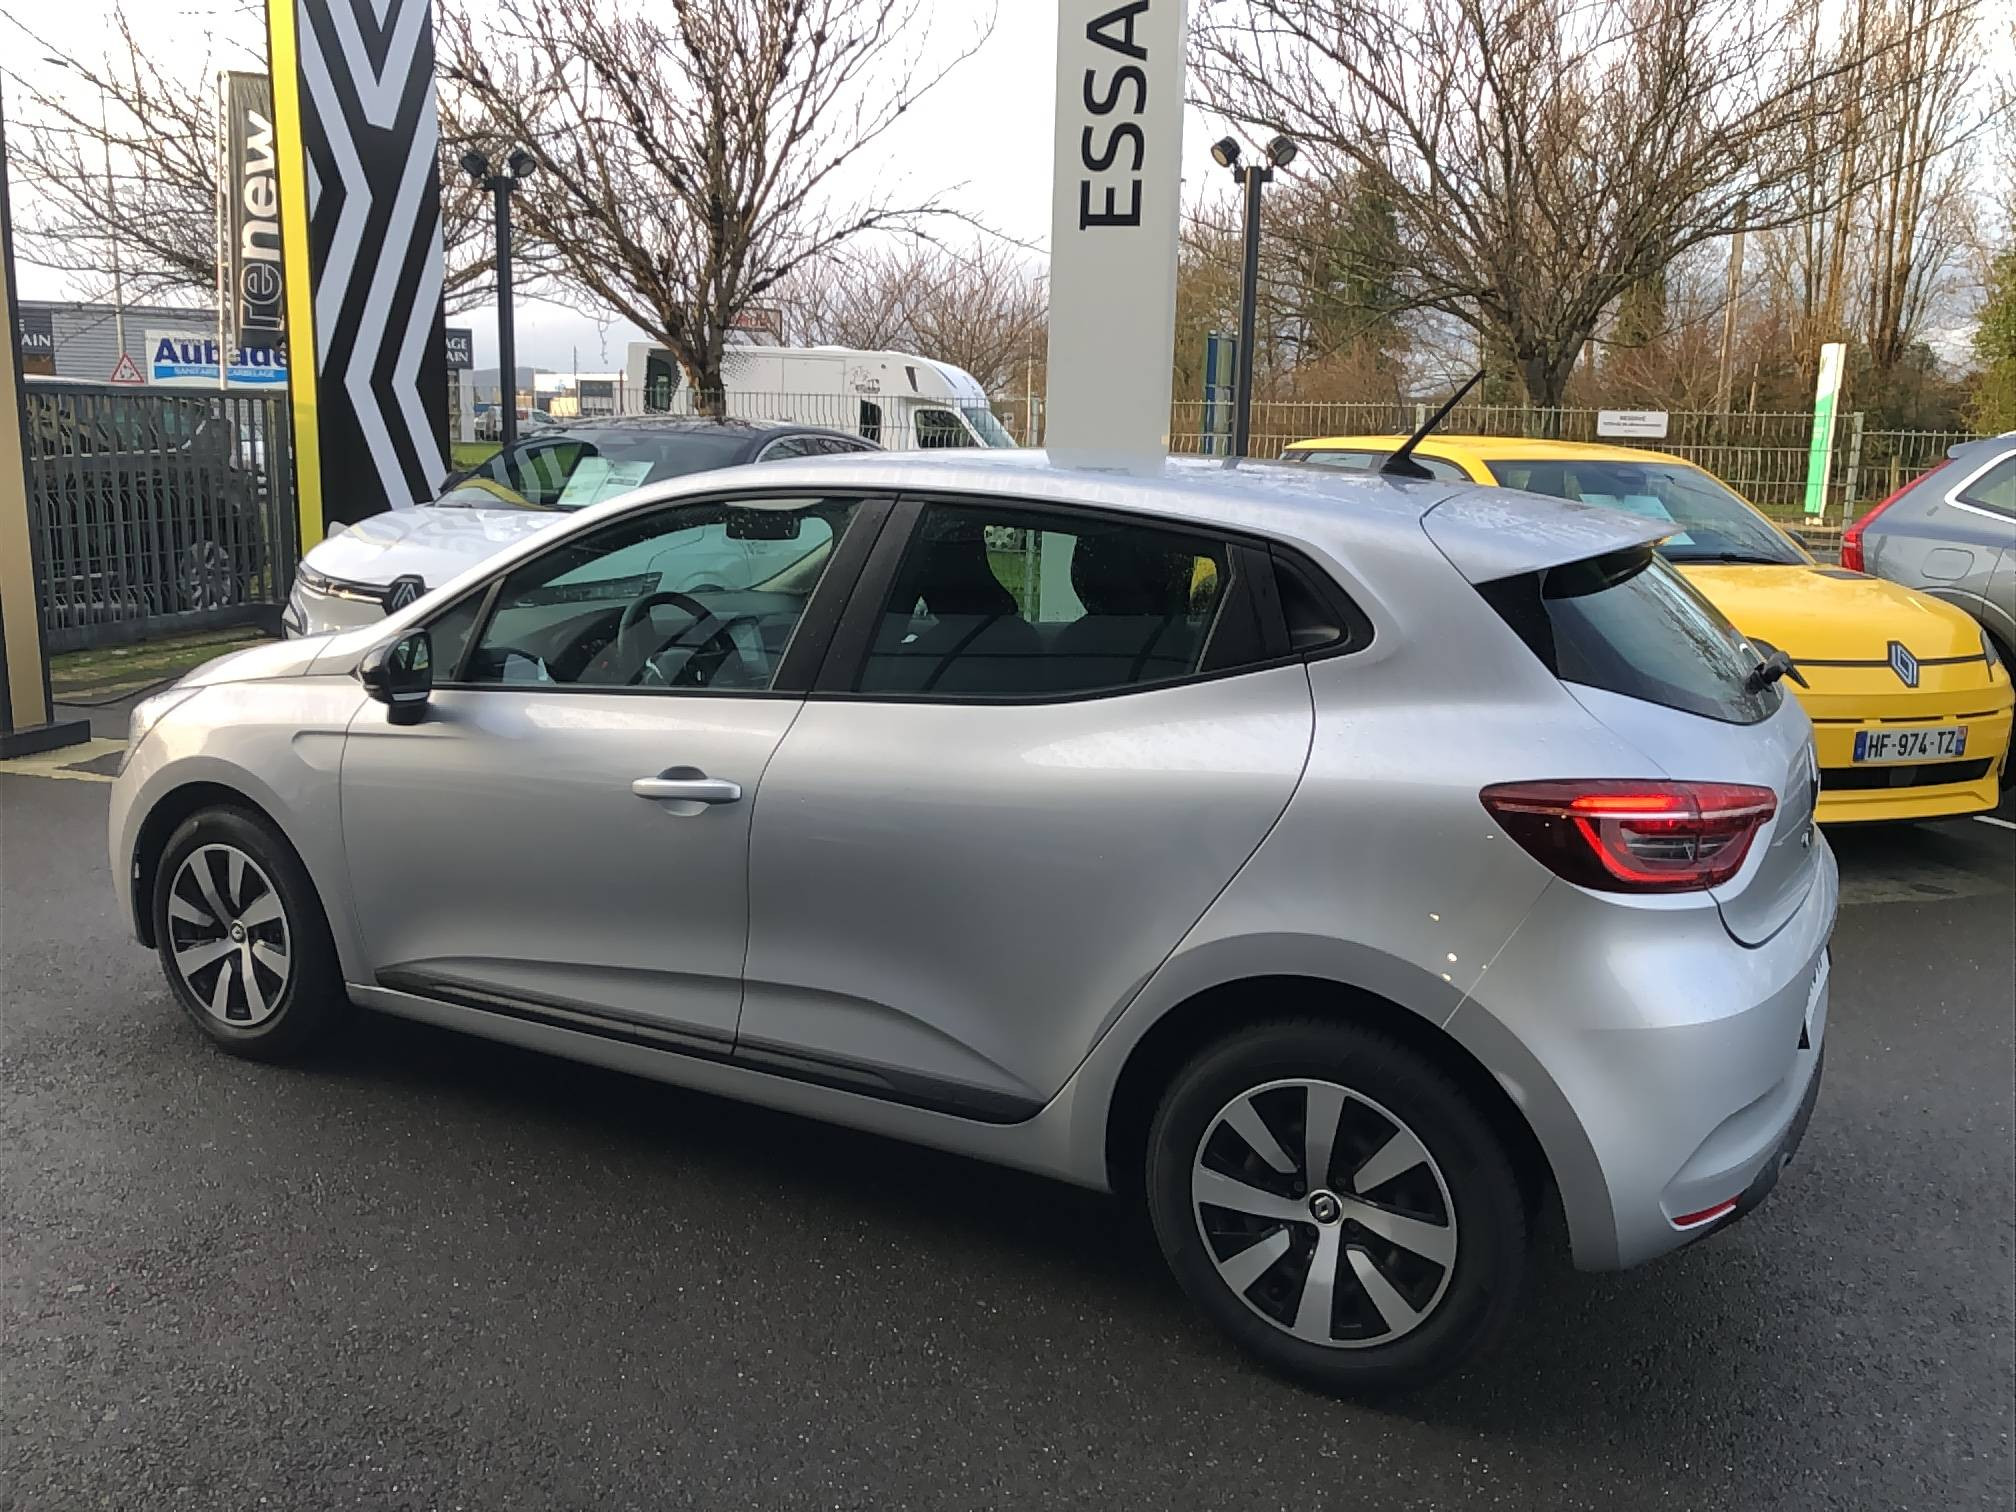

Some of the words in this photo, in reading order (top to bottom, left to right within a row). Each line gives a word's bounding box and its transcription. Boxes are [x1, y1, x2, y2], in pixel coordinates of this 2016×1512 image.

[241, 109, 284, 332] renew
[1080, 0, 1149, 231] ESSA
[1868, 731, 1956, 758] HF-974-TZ
